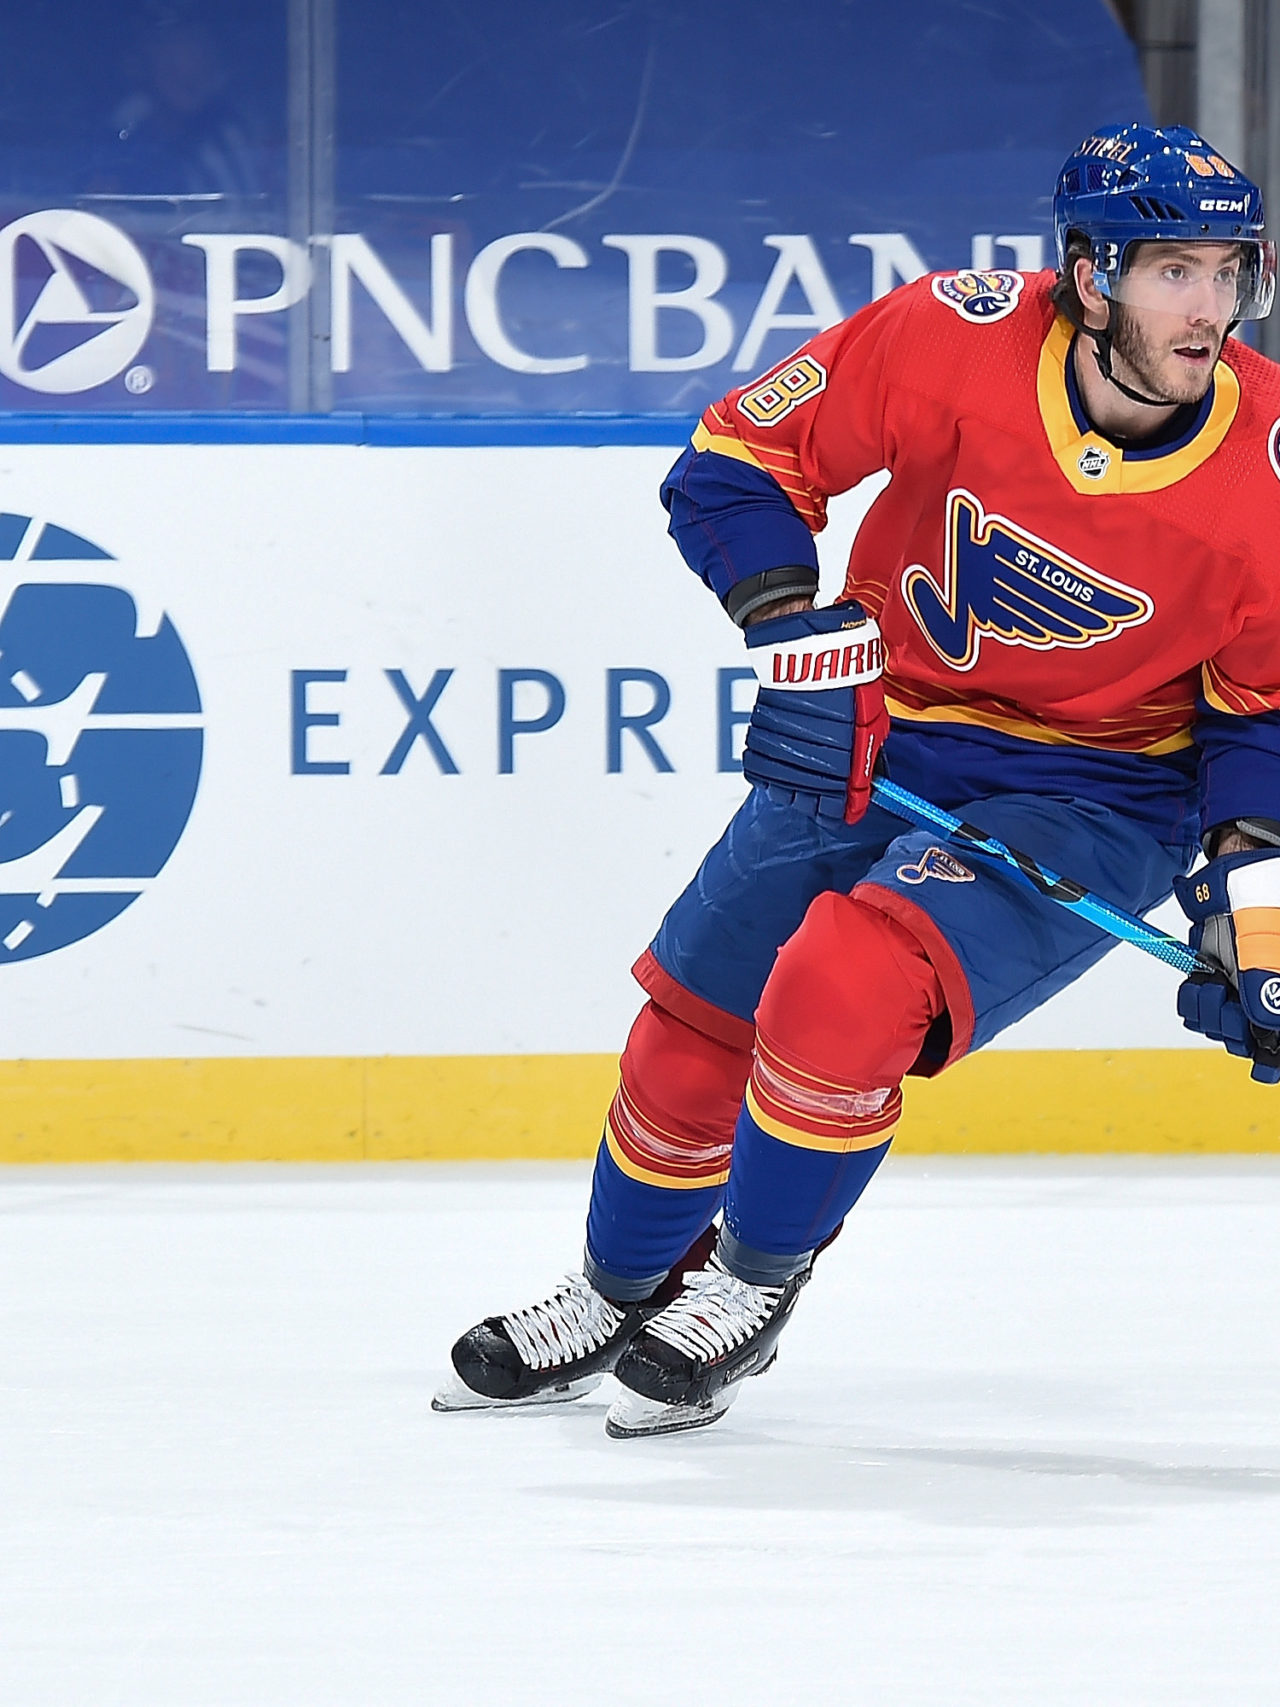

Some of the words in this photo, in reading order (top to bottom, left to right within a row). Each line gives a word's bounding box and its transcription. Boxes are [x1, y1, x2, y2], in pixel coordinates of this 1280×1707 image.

[1073, 135, 1132, 165] STIEL
[1185, 154, 1235, 178] 68
[1200, 199, 1243, 213] CCM
[1014, 550, 1038, 574] ST.
[1041, 564, 1095, 602] LOUIS
[289, 667, 760, 776] EXPRE
[1195, 882, 1211, 903] 68
